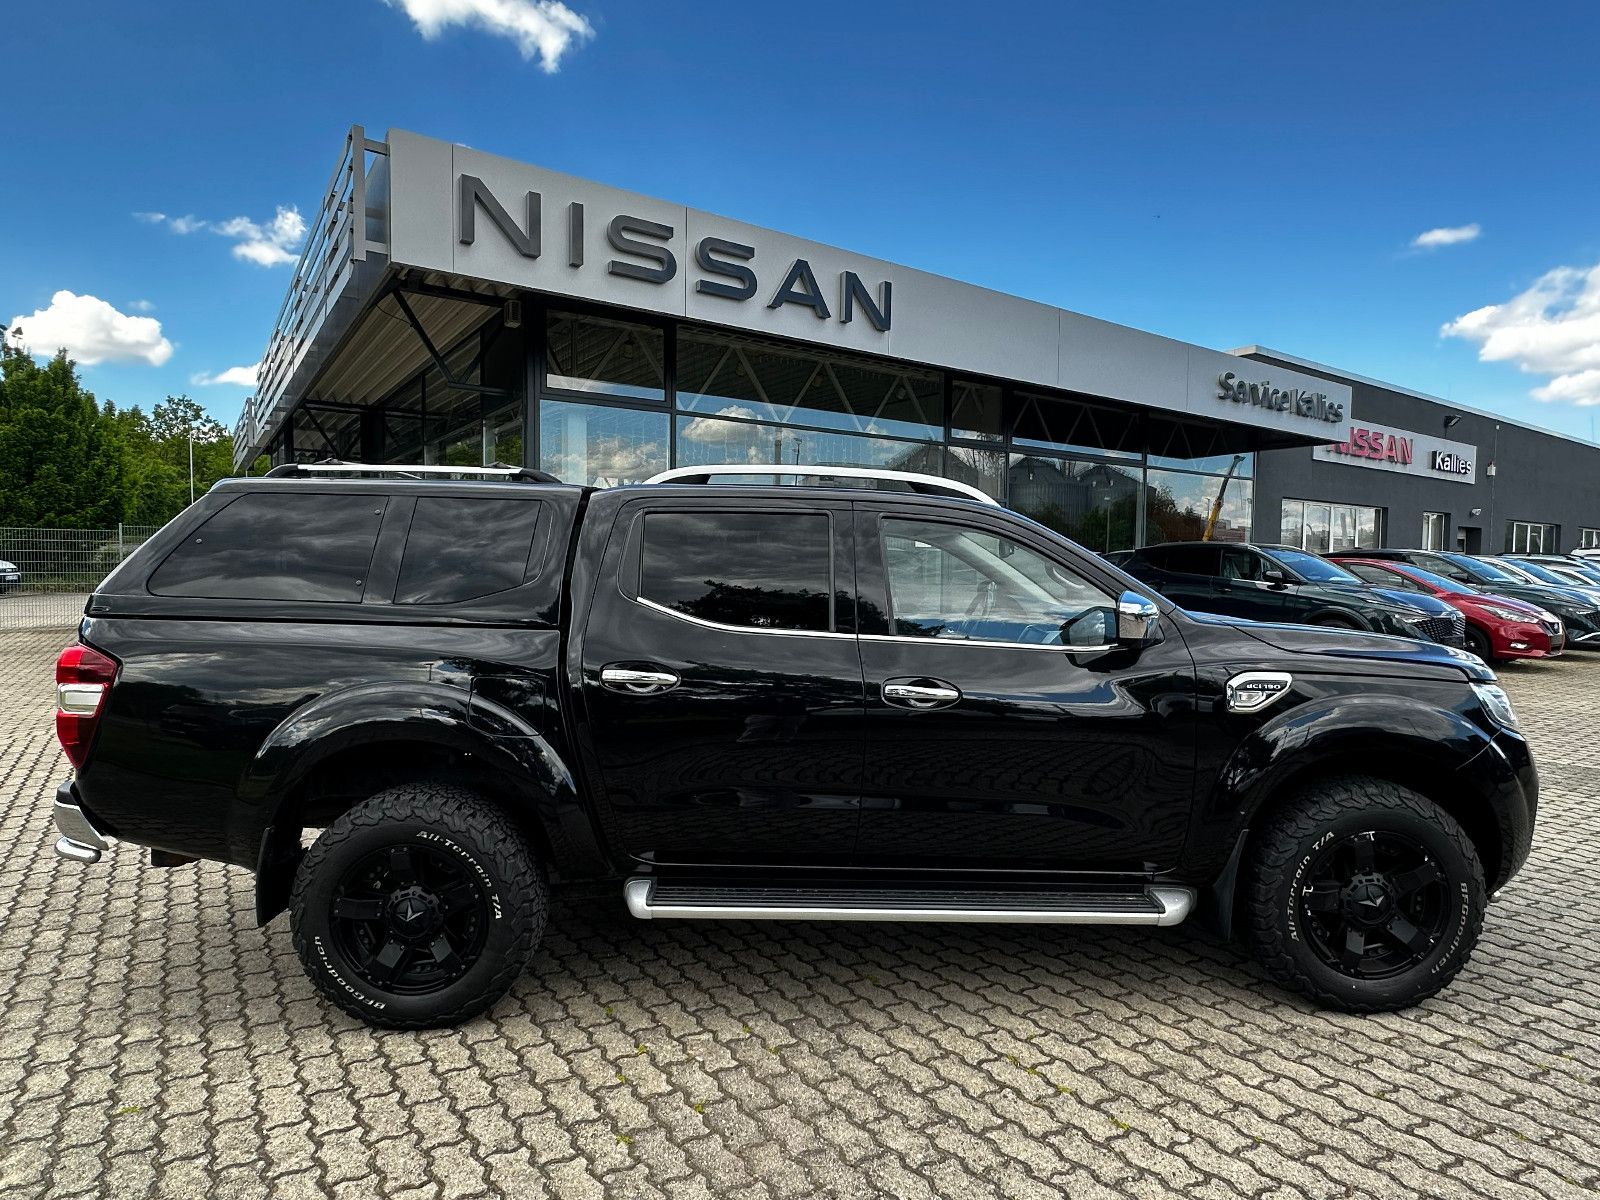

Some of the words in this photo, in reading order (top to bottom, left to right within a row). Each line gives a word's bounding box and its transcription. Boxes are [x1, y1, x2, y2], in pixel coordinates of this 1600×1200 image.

[459, 174, 892, 332] NISSAN
[1432, 450, 1472, 475] Kallies
[416, 830, 492, 888] All-Terrain
[491, 893, 503, 920] T/A
[1287, 855, 1311, 942] All-Terrain
[1312, 831, 1335, 851] T/A
[314, 936, 387, 1010] BFGoodrich
[1430, 882, 1469, 974] BFGoodrich
